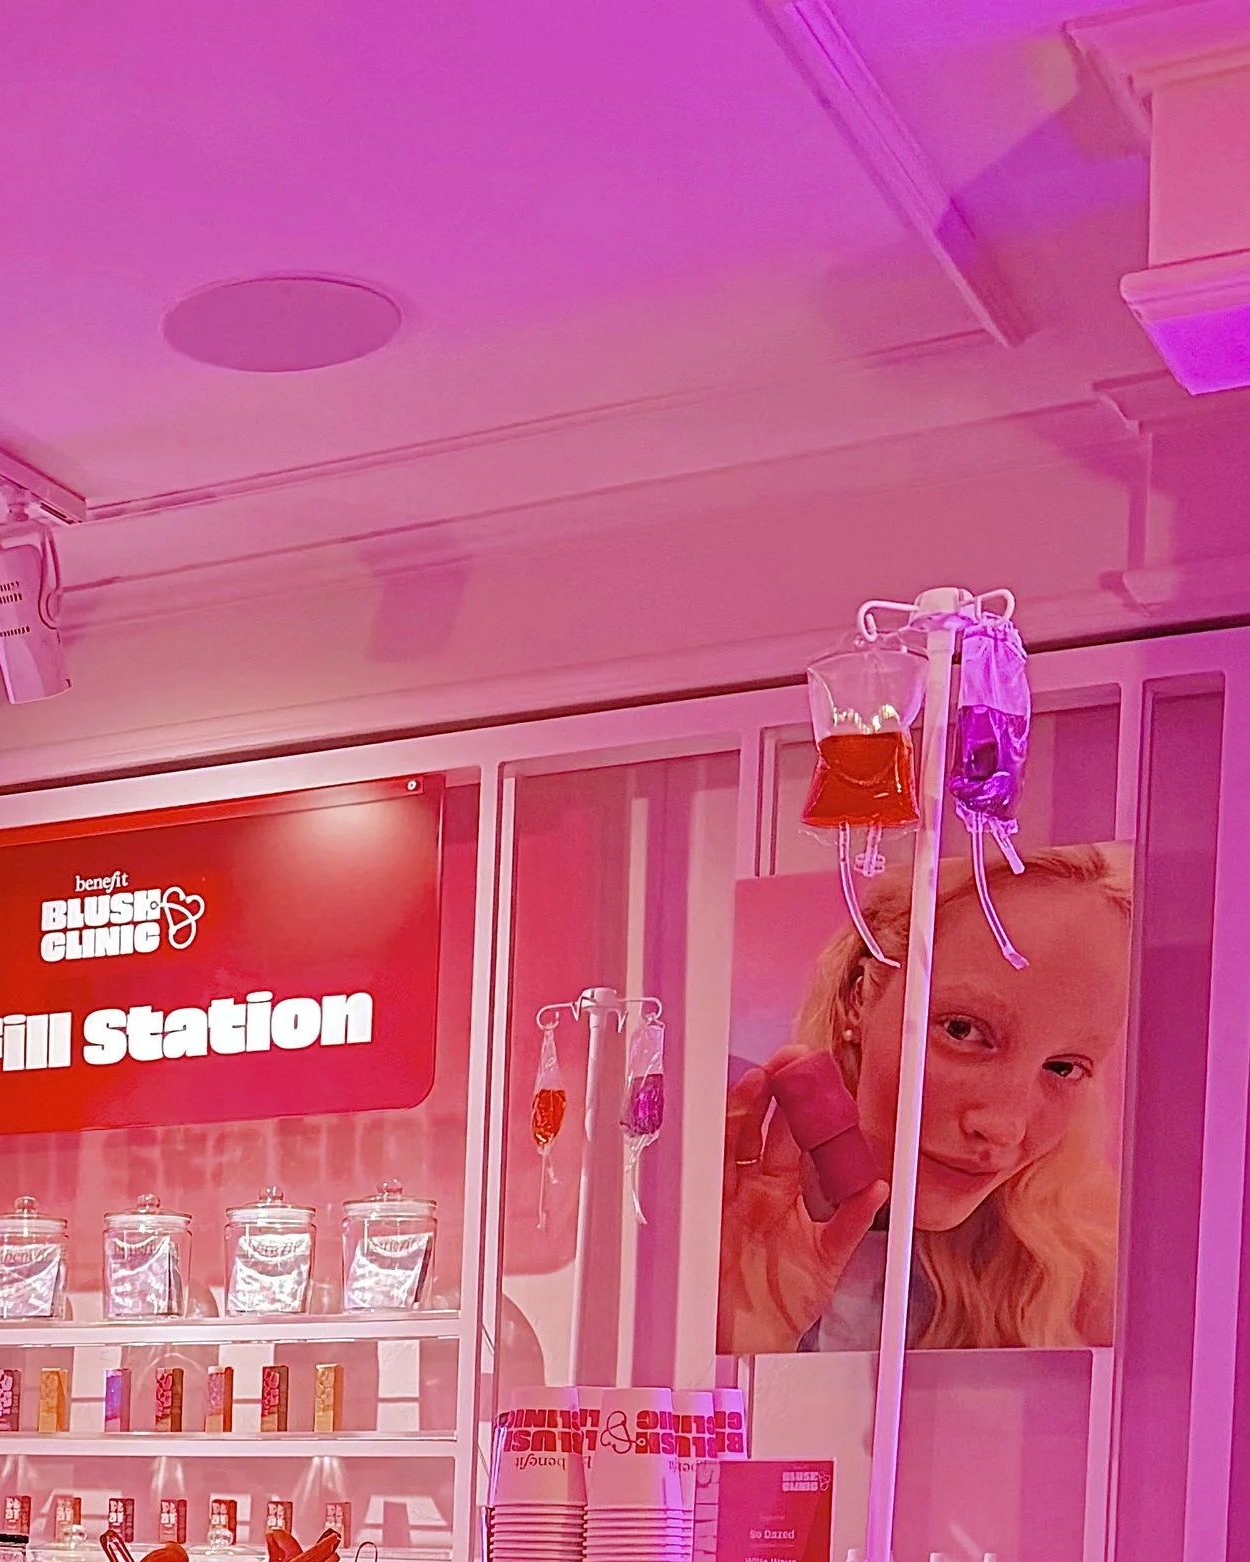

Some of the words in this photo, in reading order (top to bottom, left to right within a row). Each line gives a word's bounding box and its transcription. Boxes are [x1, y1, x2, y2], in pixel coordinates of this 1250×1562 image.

[75, 870, 128, 893] benefit
[41, 888, 162, 932] BLUSH
[41, 922, 161, 962] CLINIC
[82, 990, 373, 1066] Station
[515, 1453, 566, 1471] benefit
[764, 1529, 795, 1539] Dazed
